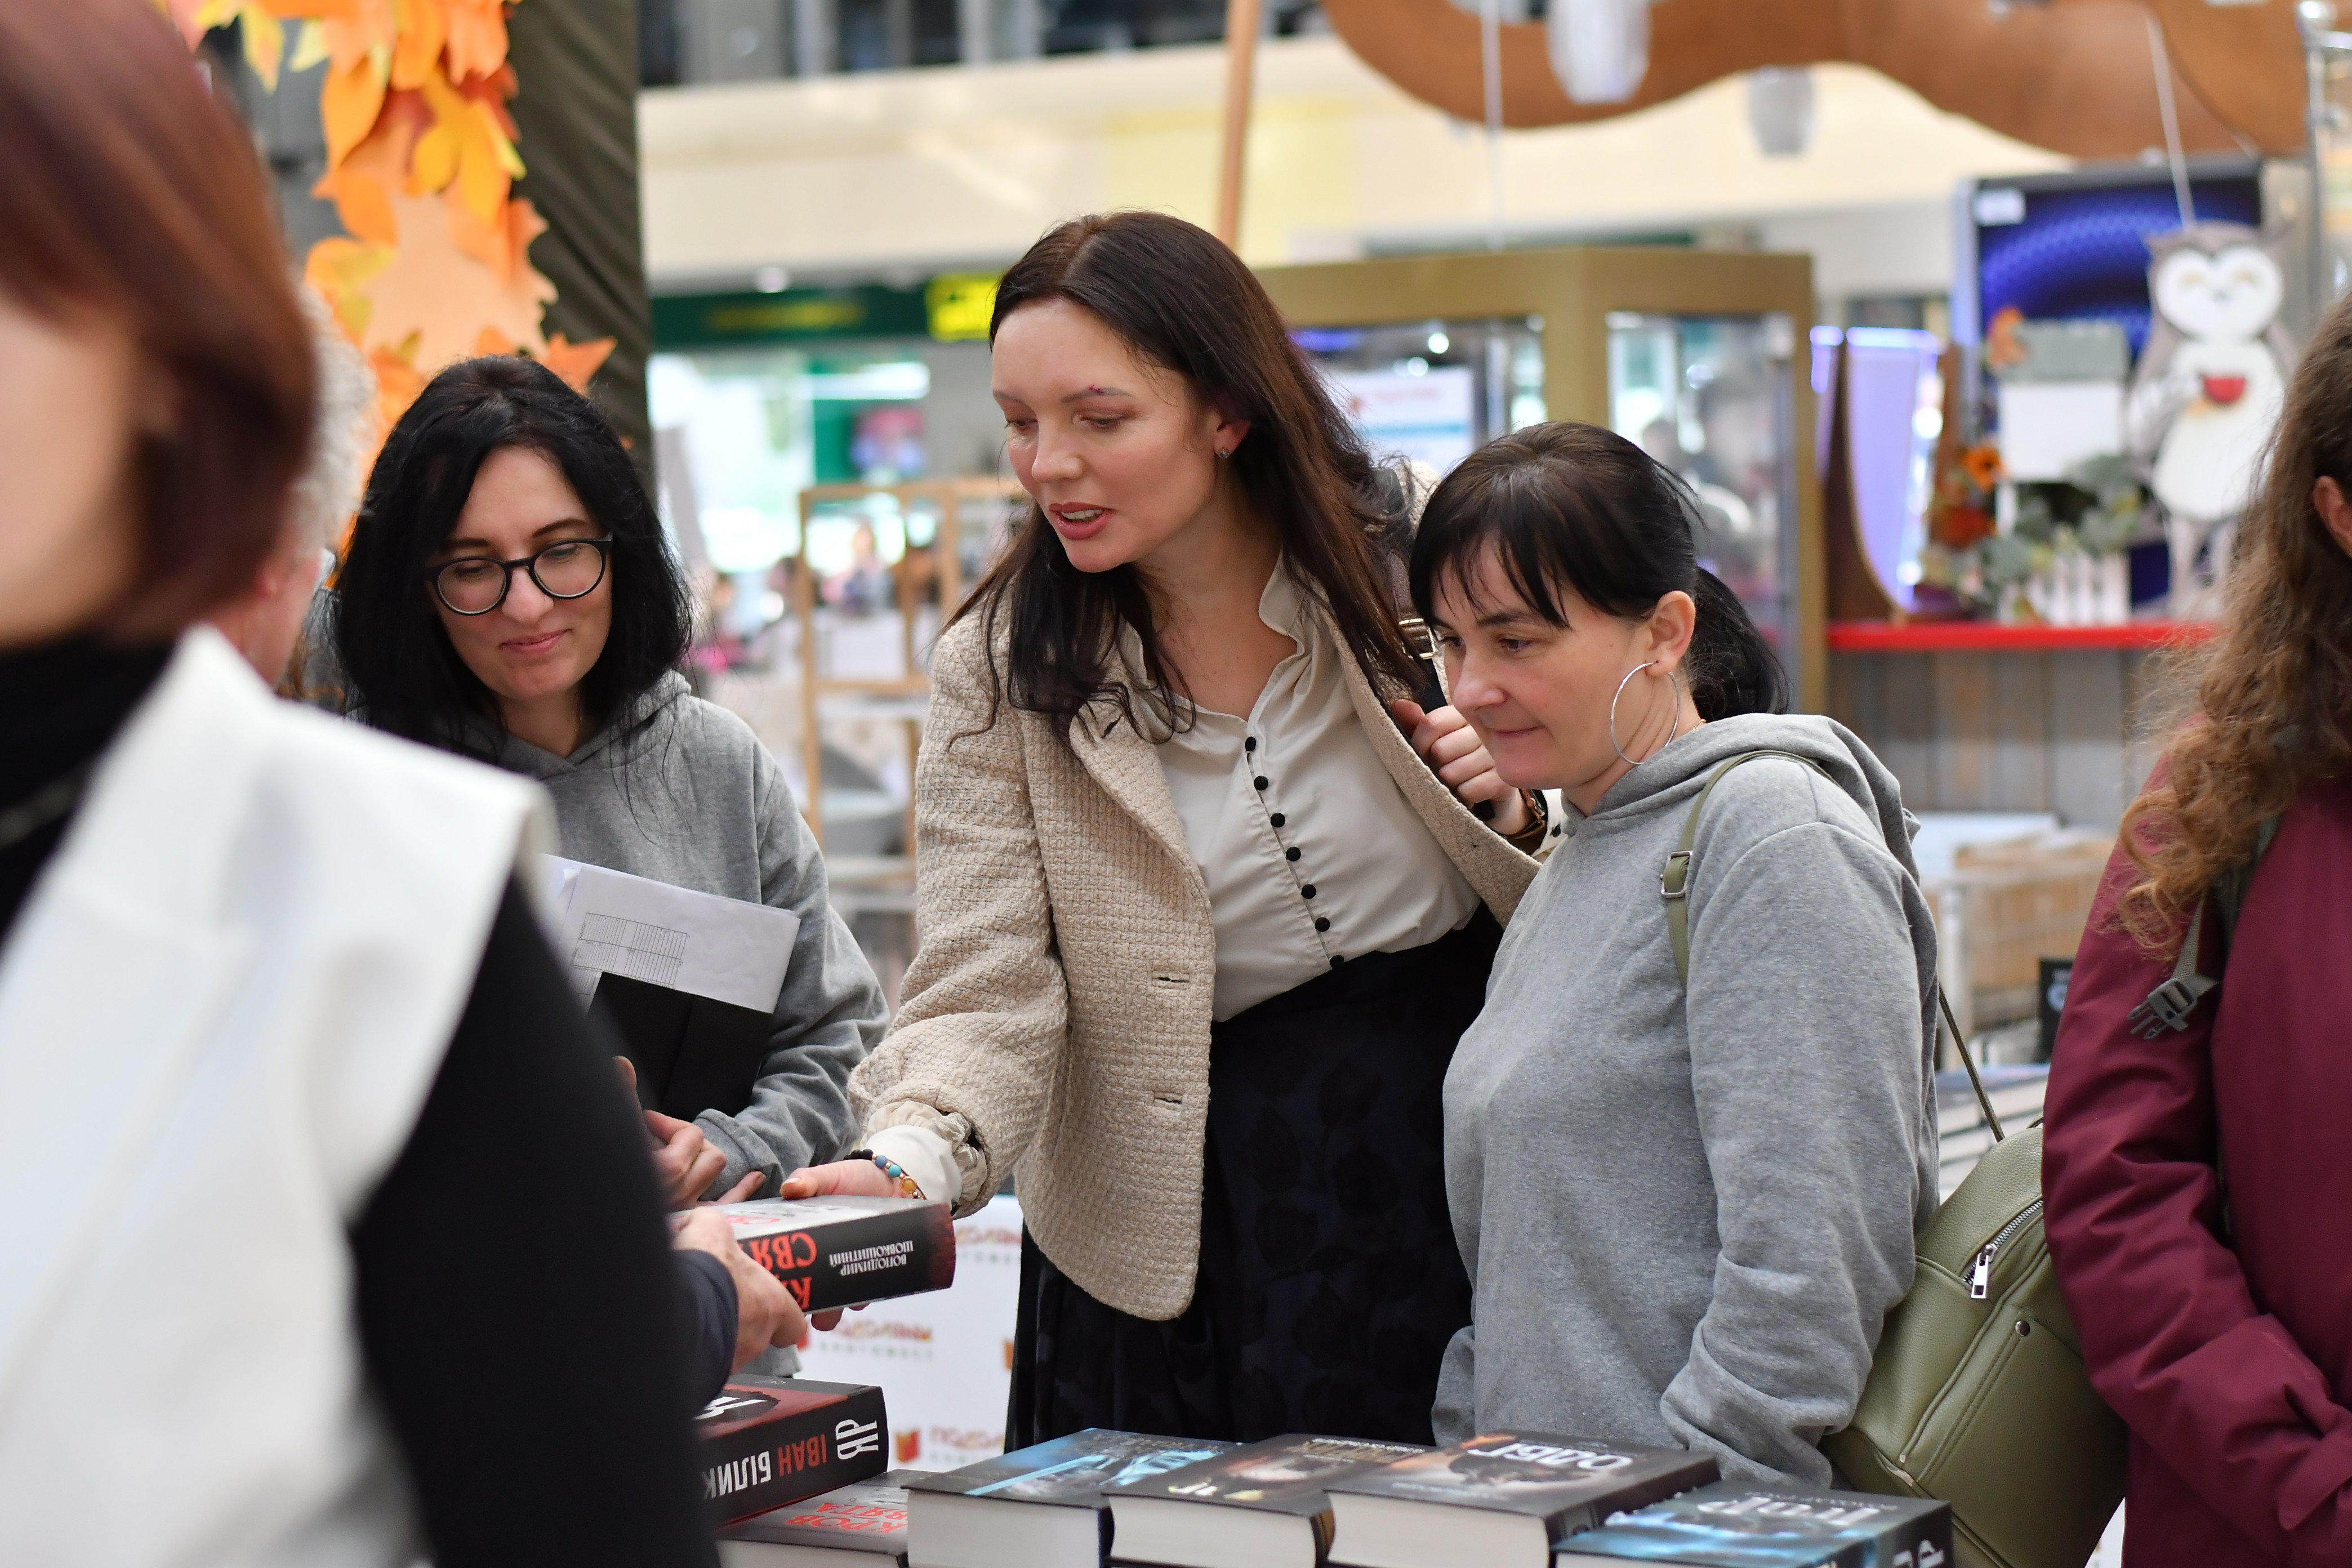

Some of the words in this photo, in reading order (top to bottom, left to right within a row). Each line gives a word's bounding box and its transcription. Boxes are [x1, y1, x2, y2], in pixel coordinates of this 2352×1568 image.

[736, 1232, 817, 1271] СВЯ
[828, 1240, 914, 1267] ШОВКОШИТНИЙ
[839, 1253, 907, 1277] ВОЛОДИМИР
[778, 1434, 827, 1477] ІВАН
[835, 1419, 879, 1460] ЯР
[702, 1450, 772, 1500] БІЛИК
[785, 1514, 908, 1534] КРОВ
[816, 1502, 908, 1522] ВЯТА
